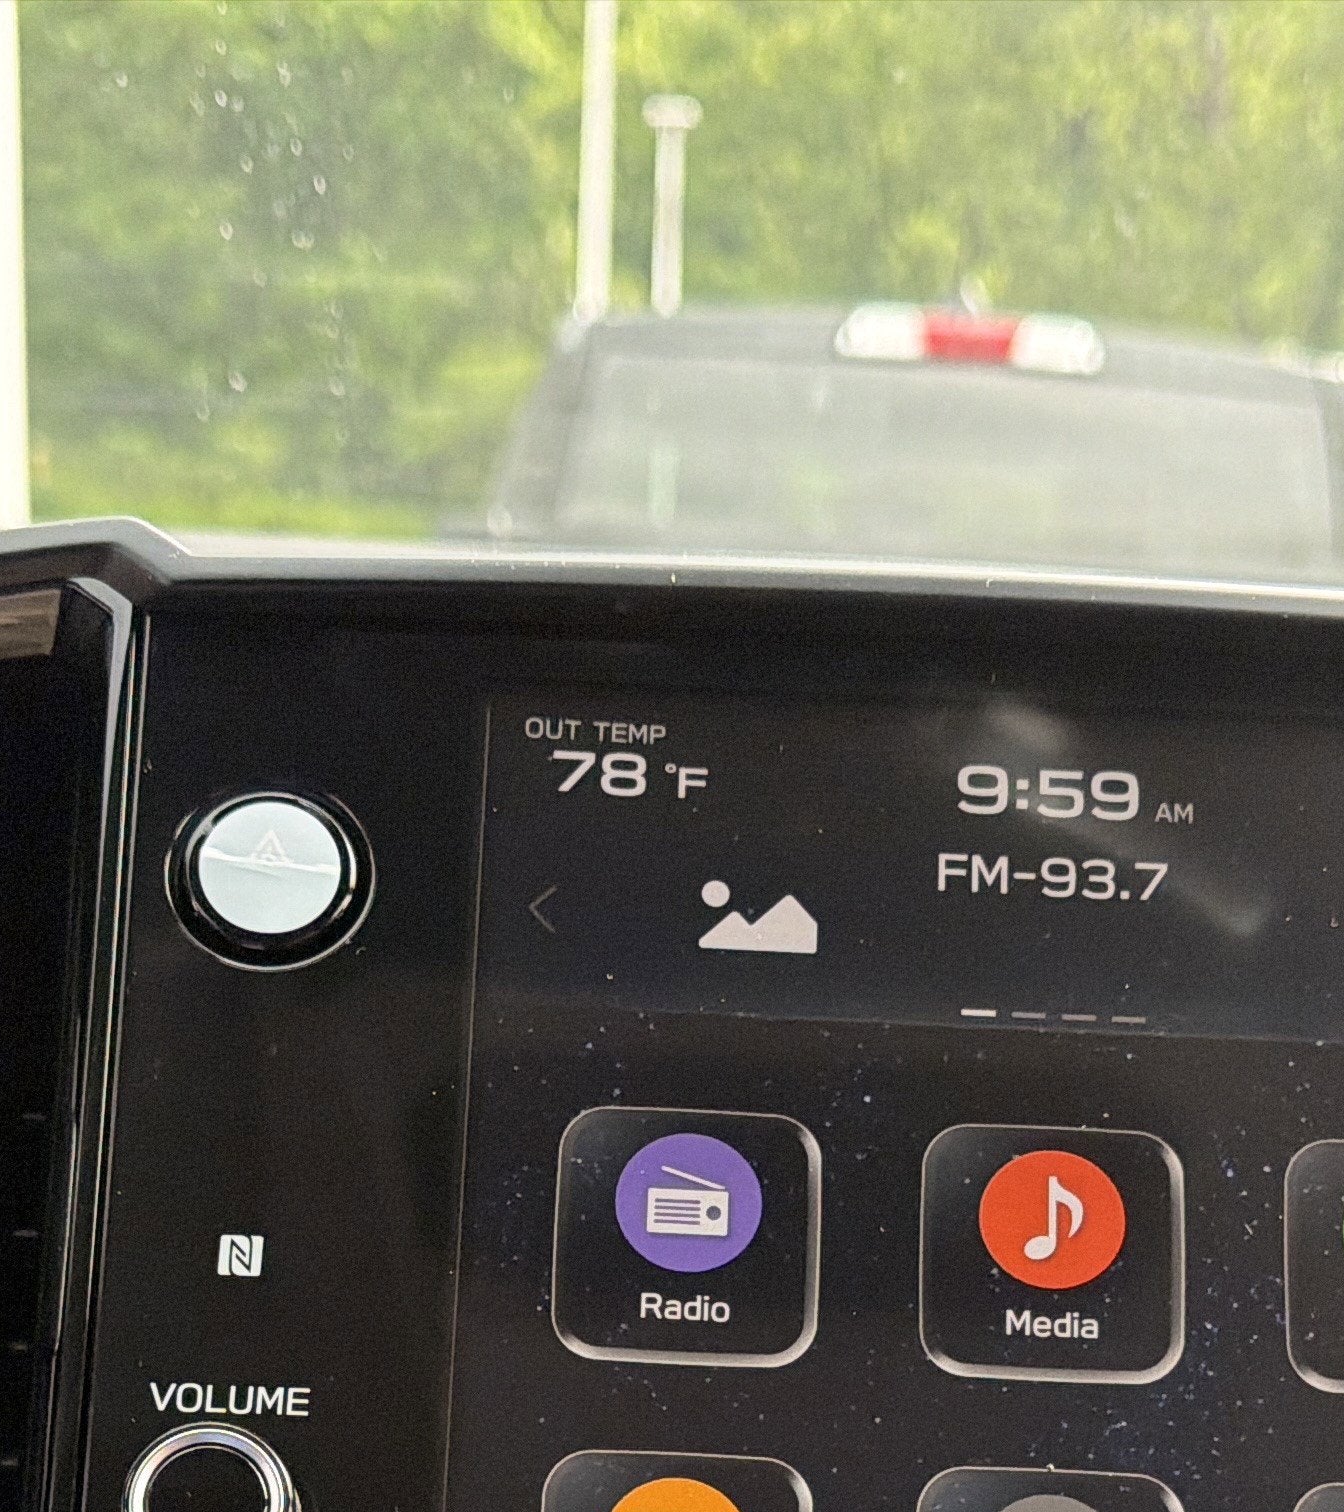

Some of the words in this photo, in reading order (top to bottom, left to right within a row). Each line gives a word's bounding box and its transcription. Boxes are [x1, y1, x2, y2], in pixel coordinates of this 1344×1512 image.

[524, 716, 582, 743] OUT
[593, 718, 667, 747] TEMP
[550, 749, 648, 798] 78
[957, 764, 1141, 822] 9:59
[1154, 802, 1195, 825] AM
[936, 852, 1170, 902] FM-93.7
[638, 1291, 731, 1324] Radio
[1003, 1309, 1100, 1341] Media
[149, 1381, 312, 1417] VOLUME
